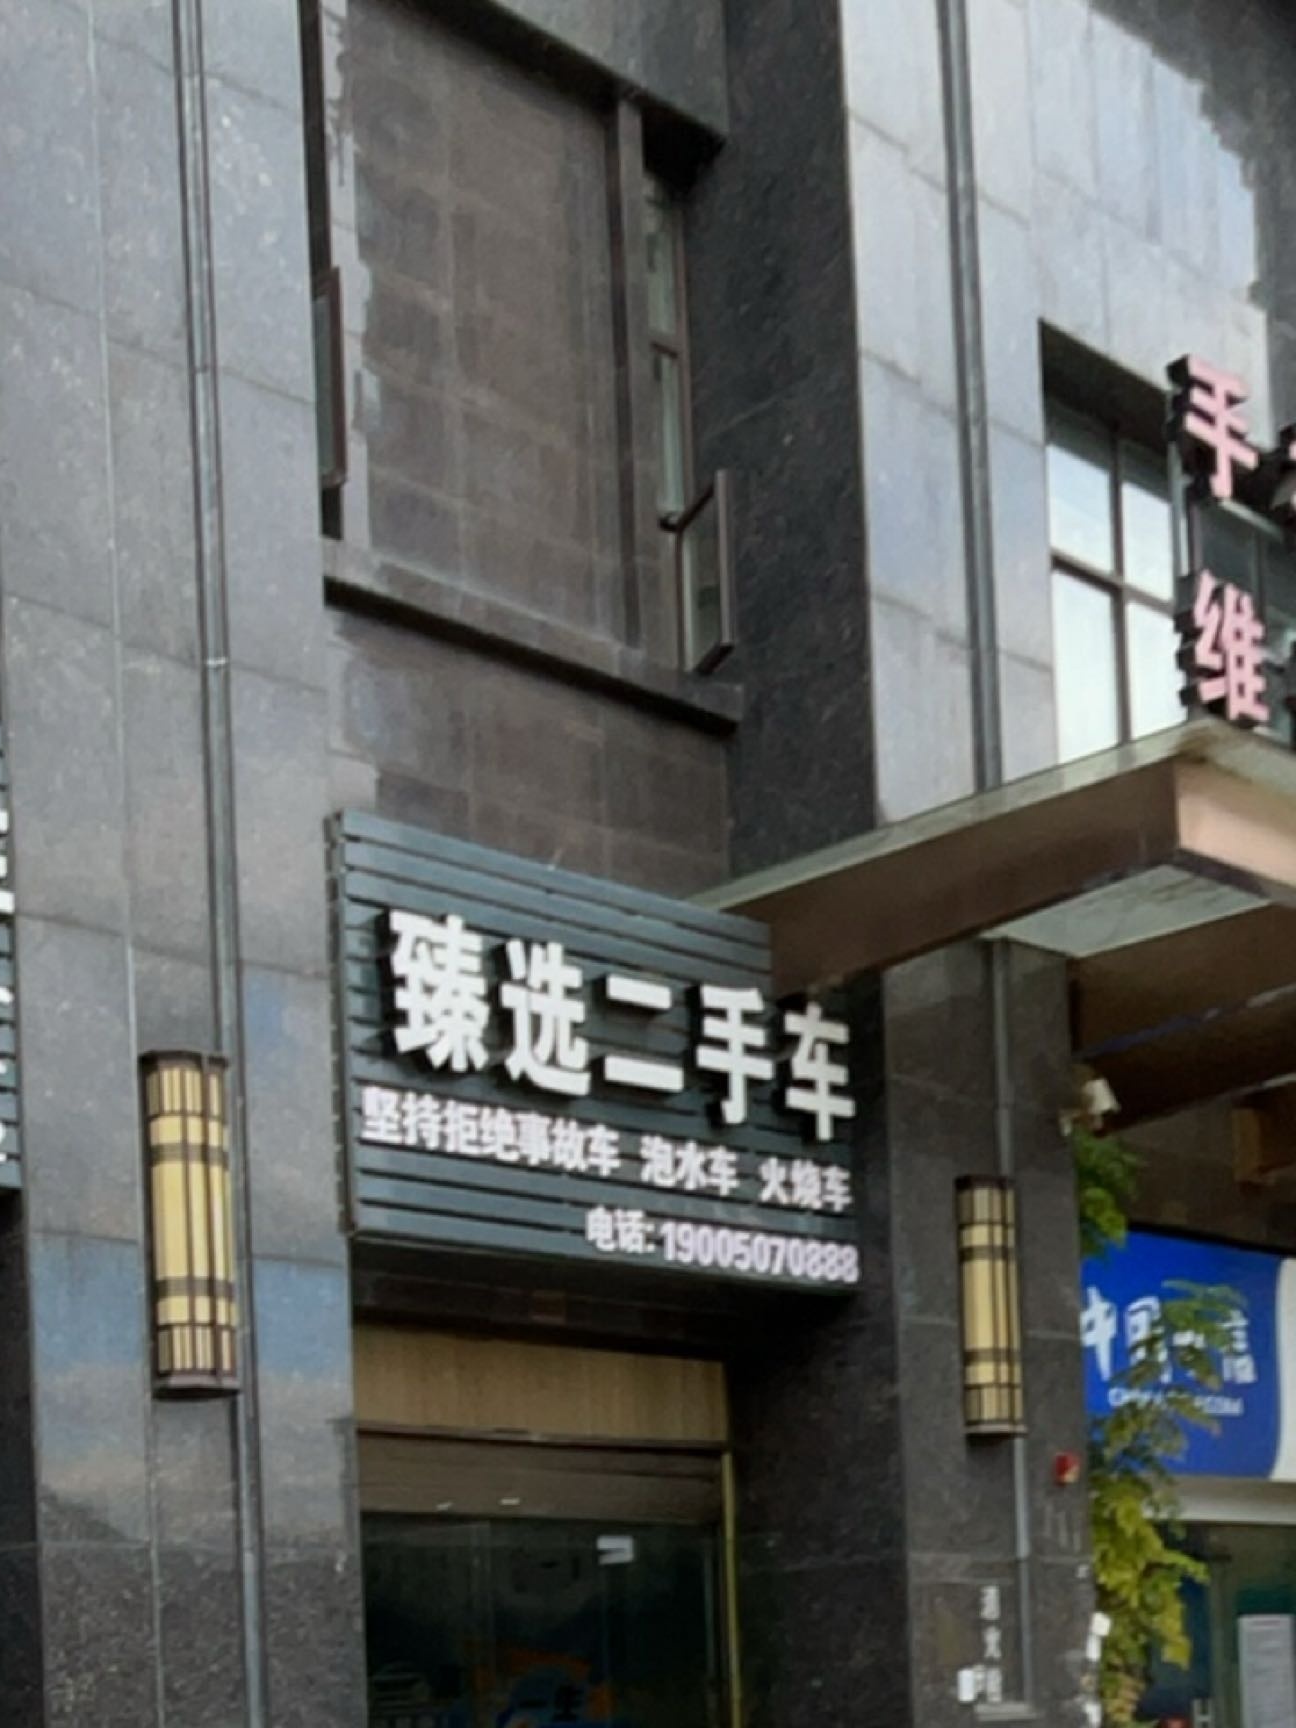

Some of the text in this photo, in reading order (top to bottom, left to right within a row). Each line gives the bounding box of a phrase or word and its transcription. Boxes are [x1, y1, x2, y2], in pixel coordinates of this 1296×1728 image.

[1184, 354, 1296, 502] 手
[388, 909, 856, 1142] 臻选二手车
[360, 1085, 622, 1177] 坚持拒绝事故车
[639, 1134, 740, 1197] 泡水车
